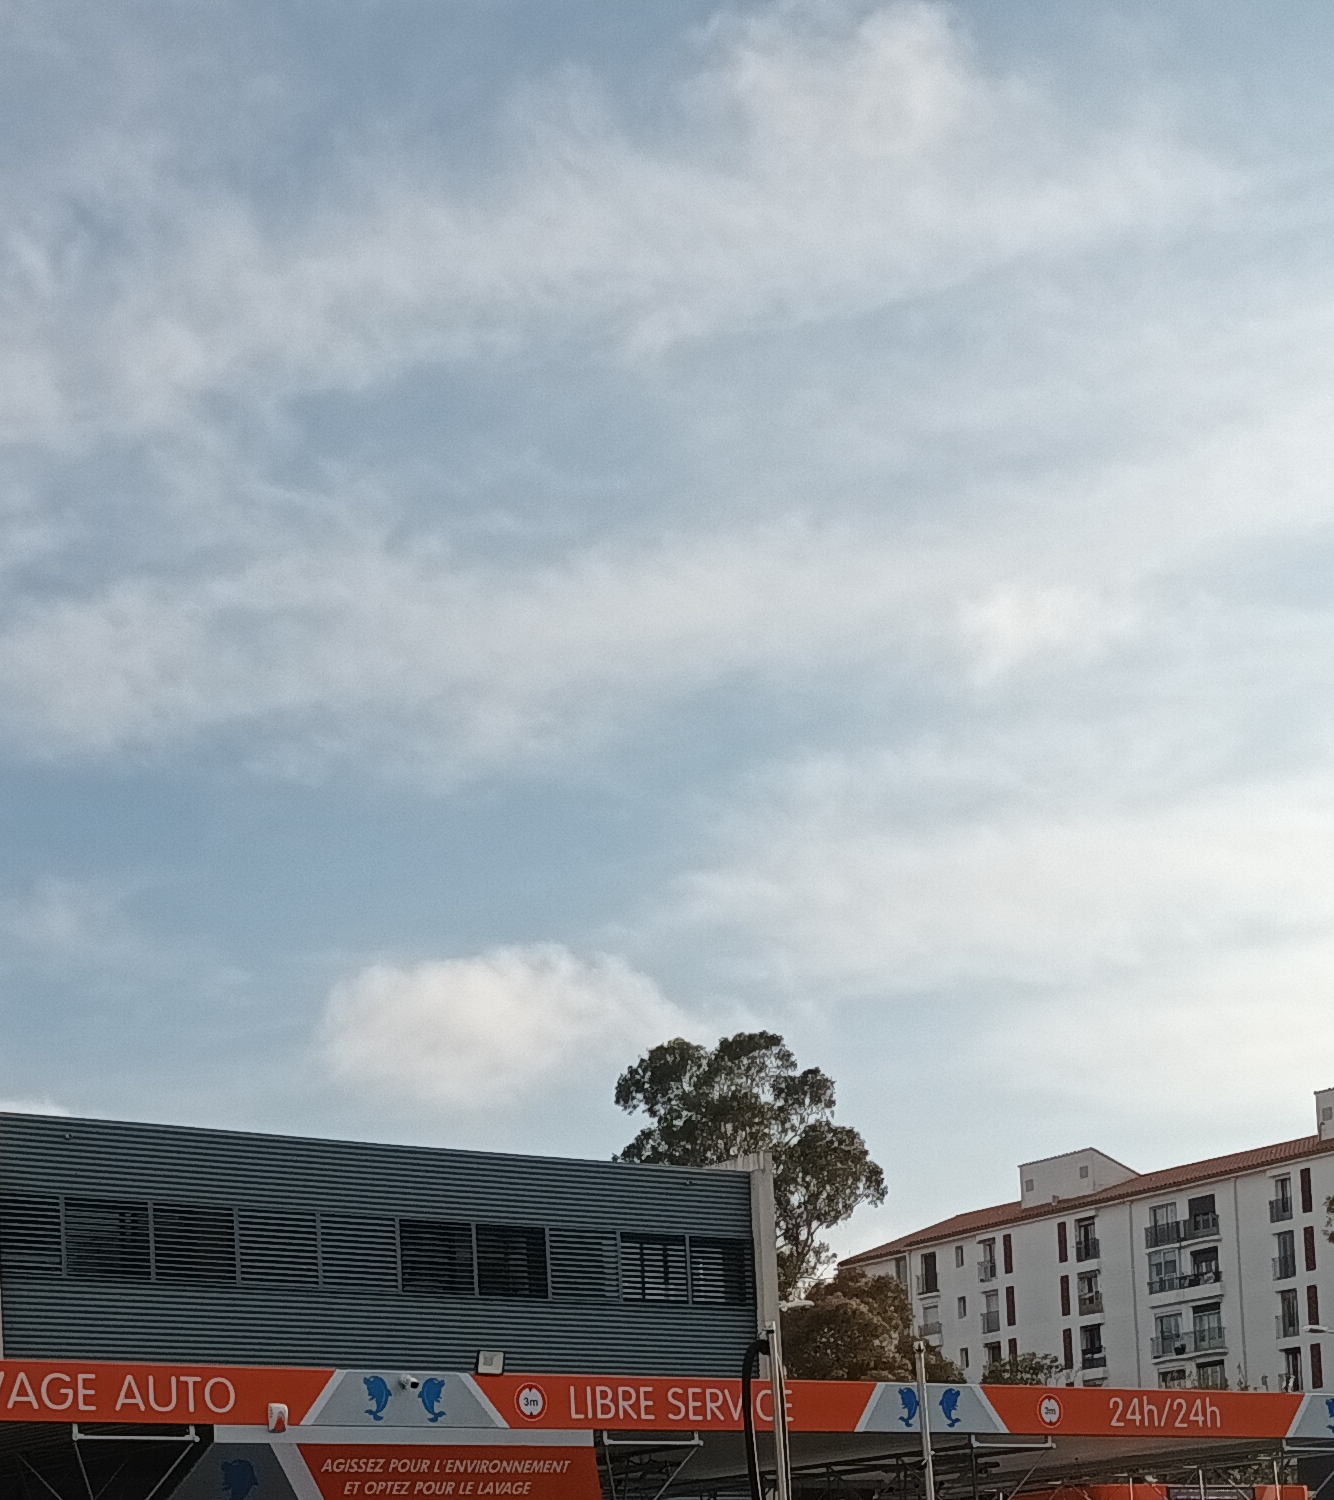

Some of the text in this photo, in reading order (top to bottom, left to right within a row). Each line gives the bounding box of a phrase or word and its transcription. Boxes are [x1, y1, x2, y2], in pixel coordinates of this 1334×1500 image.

[114, 1374, 237, 1414] AUTO
[522, 1396, 539, 1408] 3m
[569, 1386, 795, 1422] LIBRE SERVCE
[1044, 1406, 1057, 1415] 3m
[1109, 1395, 1222, 1429] 24h/24h
[320, 1458, 571, 1475] AGISSEZ POUR L'ENVIRONNEMENT
[343, 1481, 532, 1496] ET OPTEZ POUR LE LAVAGE
